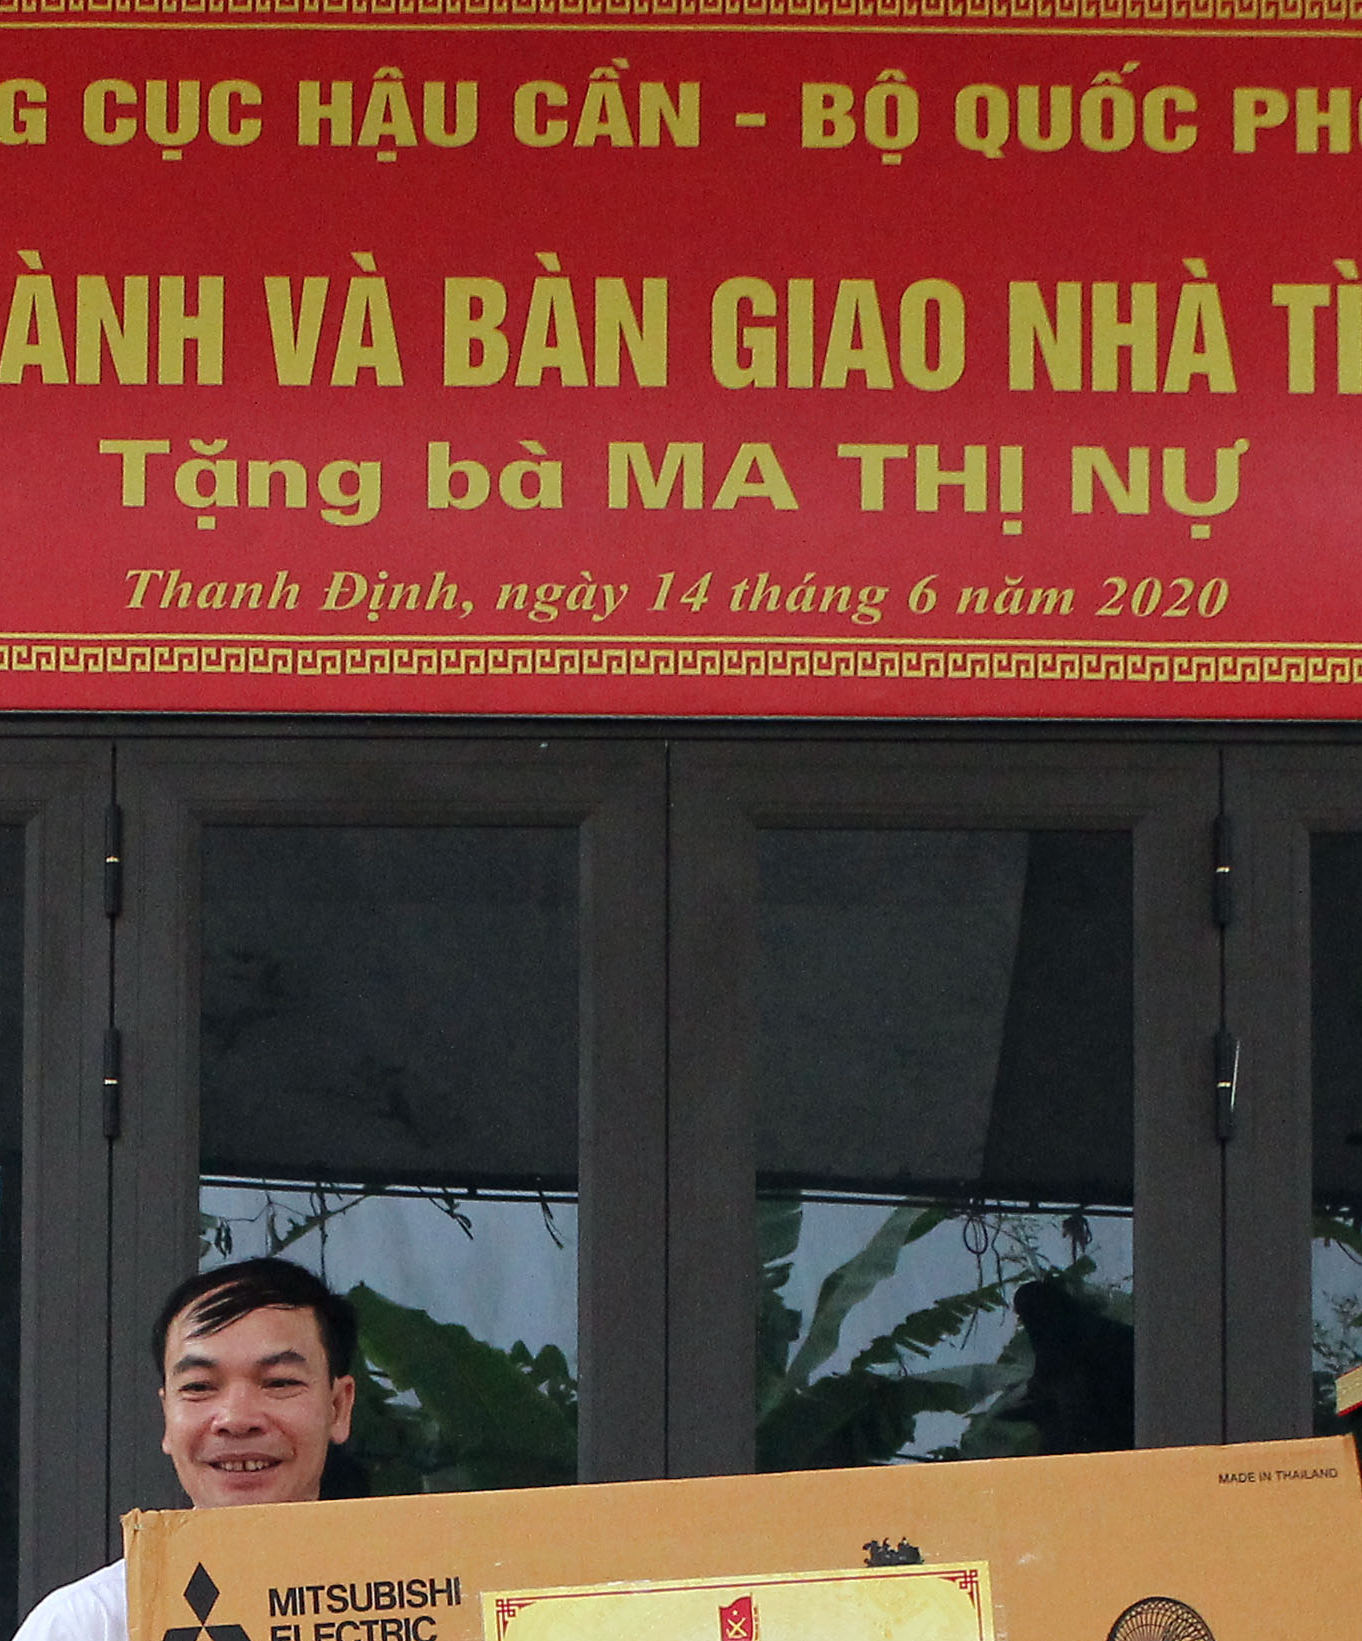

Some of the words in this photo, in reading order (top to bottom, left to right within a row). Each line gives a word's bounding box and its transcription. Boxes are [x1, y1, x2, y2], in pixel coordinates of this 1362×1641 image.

[84, 79, 261, 160] CỤC
[298, 67, 477, 162] HẬU
[514, 58, 699, 147] CẦN
[802, 69, 918, 164] BỘ
[955, 62, 1197, 158] QUỐC
[264, 252, 403, 386] VÀ
[444, 252, 667, 387] BÀN
[712, 276, 965, 391] GIAO
[1009, 258, 1237, 393] NHÀ
[99, 439, 381, 530] Tặng
[428, 440, 563, 510] bà
[608, 441, 799, 510] MA
[837, 443, 1023, 535] THỊ
[1071, 438, 1250, 539] NỰ
[125, 569, 299, 610] Thanh
[318, 571, 473, 621] Định,
[496, 571, 628, 622] ngày
[647, 572, 712, 612] 14
[730, 572, 889, 624] tháng
[909, 574, 939, 614] 6
[956, 576, 1074, 615] năm
[1095, 576, 1229, 617] 2020
[1219, 1472, 1256, 1484] MADE
[1259, 1471, 1271, 1482] IN
[1276, 1468, 1338, 1481] THAILAND
[268, 1577, 462, 1617] MITSUBISHI
